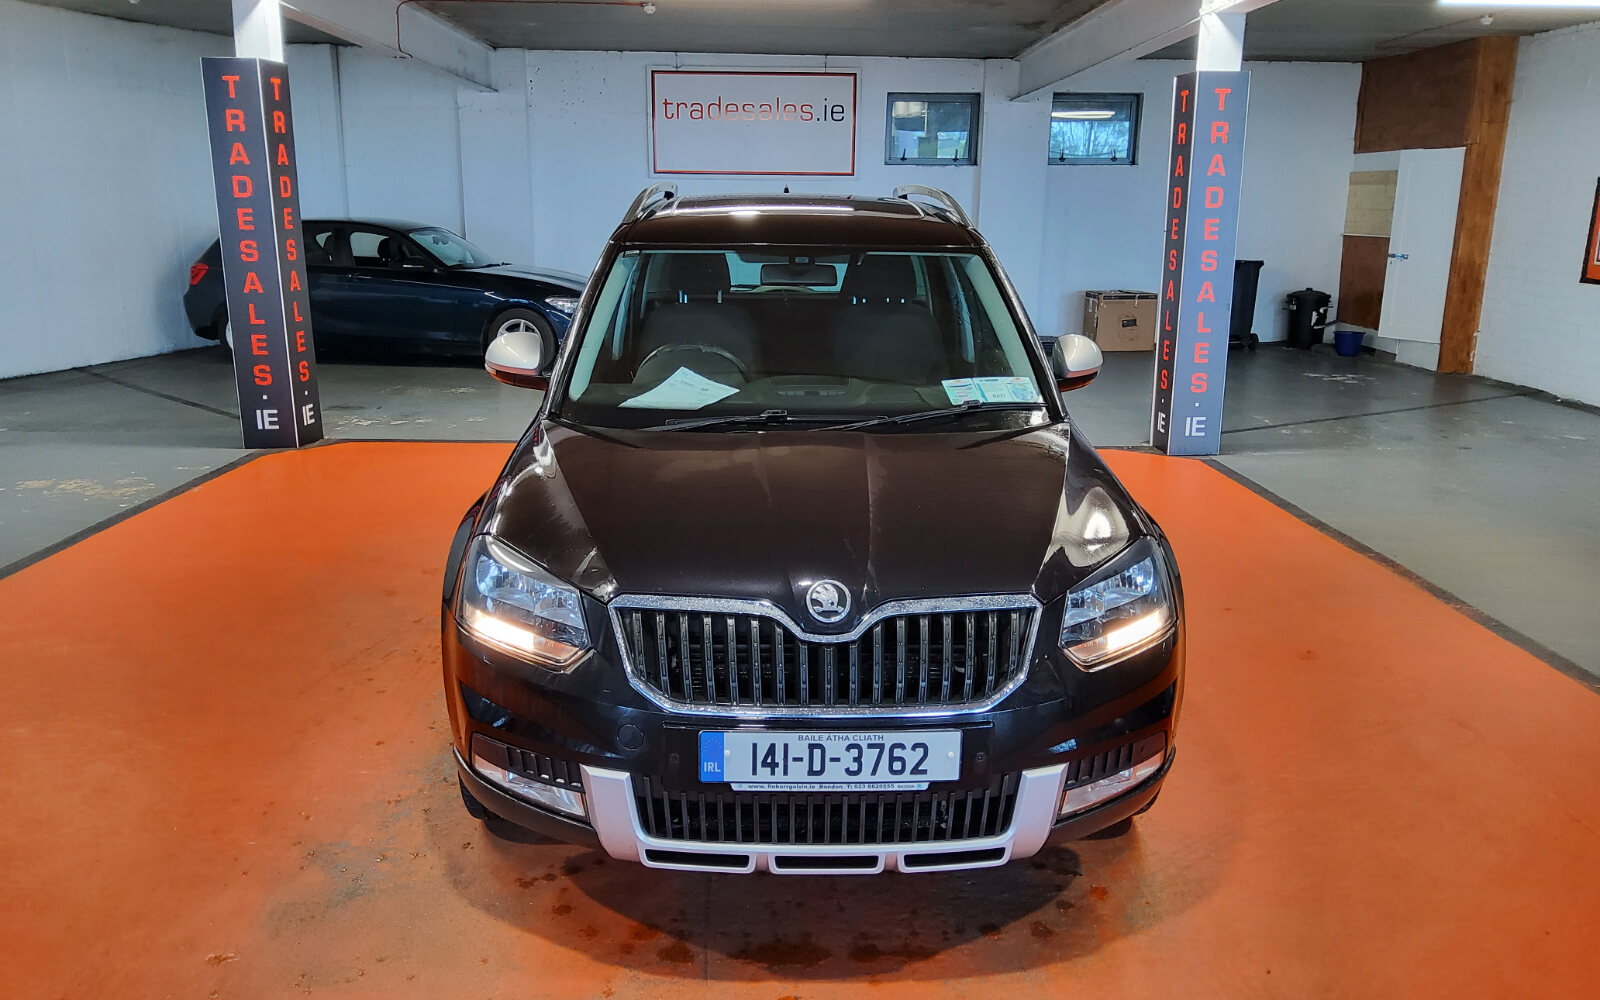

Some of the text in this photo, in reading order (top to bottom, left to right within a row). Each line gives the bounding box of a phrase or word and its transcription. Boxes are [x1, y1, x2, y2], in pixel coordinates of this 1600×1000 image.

[662, 96, 845, 122] tradesales.ie
[797, 734, 824, 742] BAILE
[852, 734, 884, 742] CLIATH
[703, 761, 721, 773] IRL
[751, 742, 929, 777] 141-D-3762
